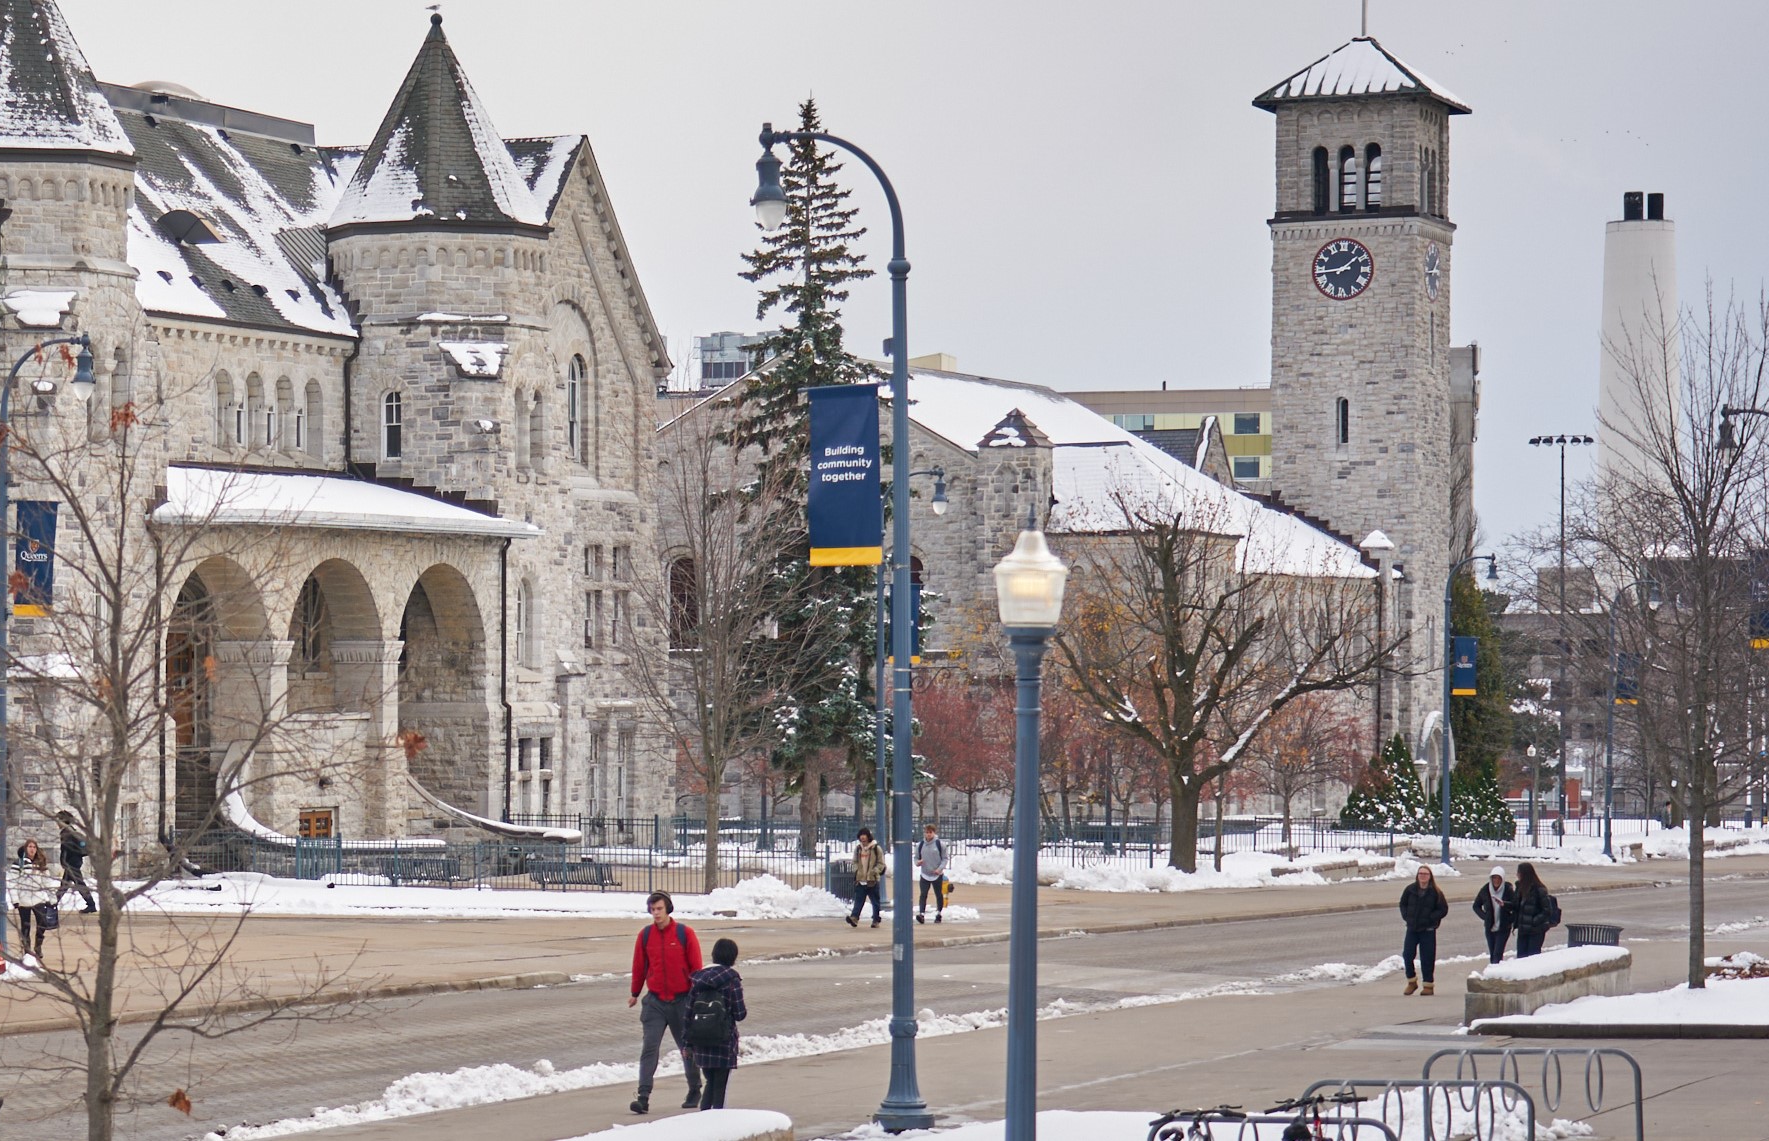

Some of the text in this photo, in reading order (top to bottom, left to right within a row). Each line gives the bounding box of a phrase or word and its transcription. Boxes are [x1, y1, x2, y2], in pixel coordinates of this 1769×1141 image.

[824, 445, 865, 457] Building
[817, 458, 872, 470] community
[821, 471, 866, 483] together
